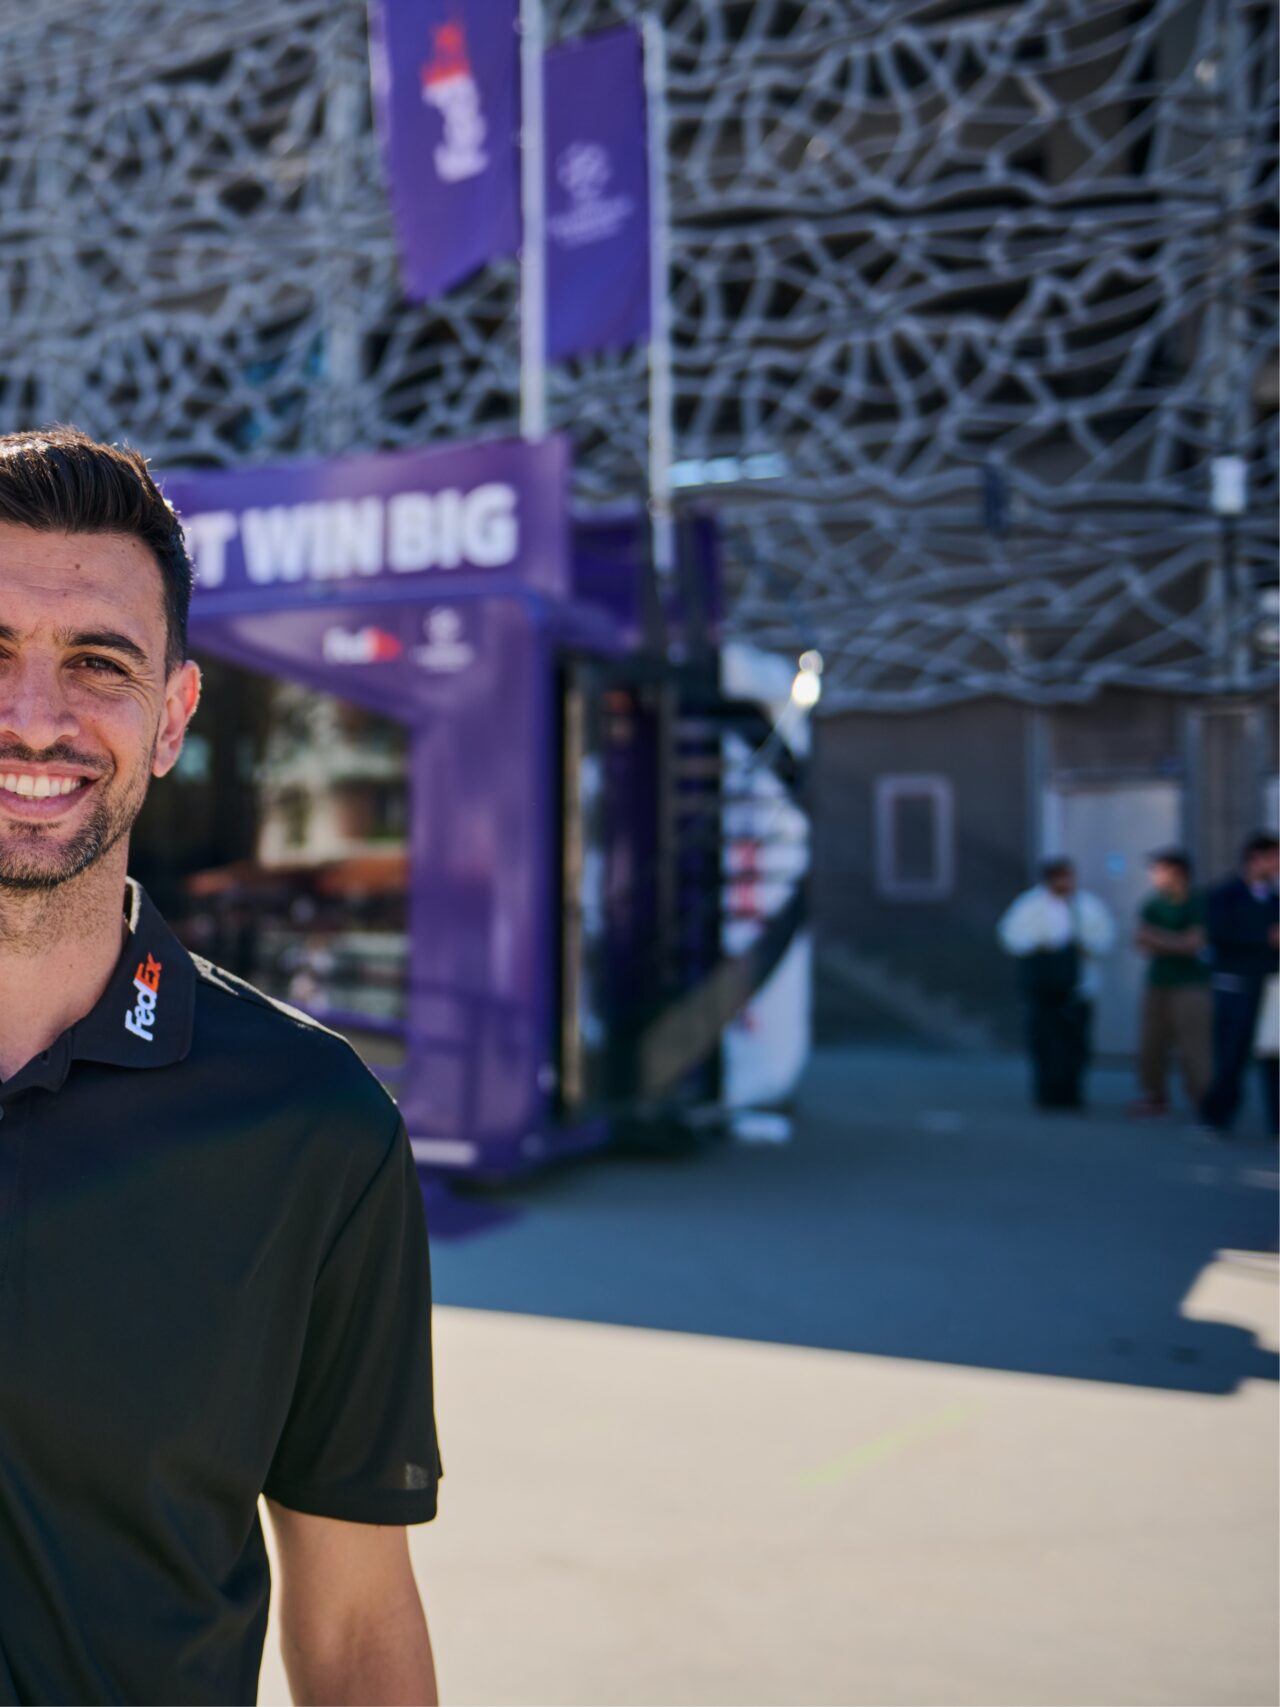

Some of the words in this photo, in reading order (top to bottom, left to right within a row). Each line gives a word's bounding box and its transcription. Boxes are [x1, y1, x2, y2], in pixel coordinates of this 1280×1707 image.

[240, 497, 385, 584] WIN
[388, 482, 518, 573] BIG
[124, 952, 162, 1041] FedEx
